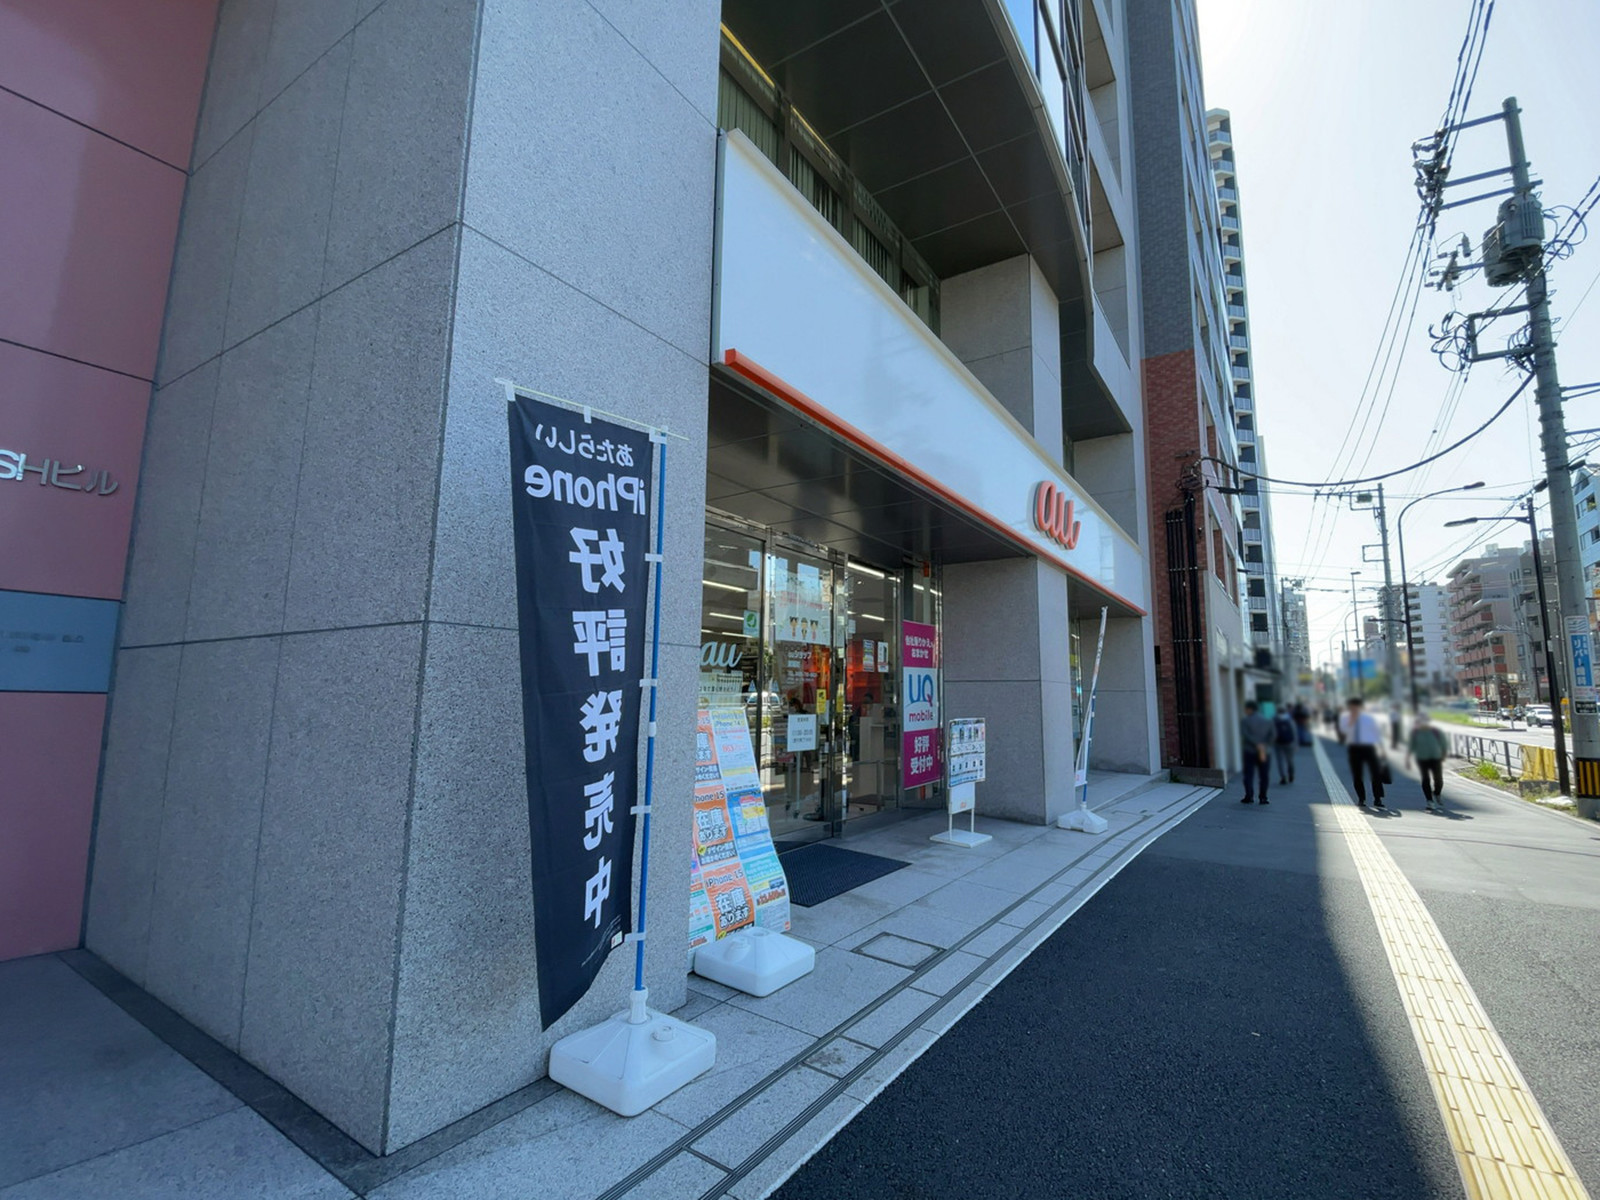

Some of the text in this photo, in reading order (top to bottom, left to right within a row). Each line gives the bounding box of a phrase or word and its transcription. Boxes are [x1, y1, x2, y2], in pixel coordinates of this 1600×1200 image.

[1034, 480, 1081, 550] au
[700, 641, 743, 668] au
[908, 674, 934, 707] UQ
[909, 709, 934, 722] mobile
[910, 754, 934, 776] 受付中
[706, 873, 732, 887] iPhone
[733, 869, 744, 879] 15
[715, 887, 746, 913] 在庫
[720, 906, 750, 928] あります
